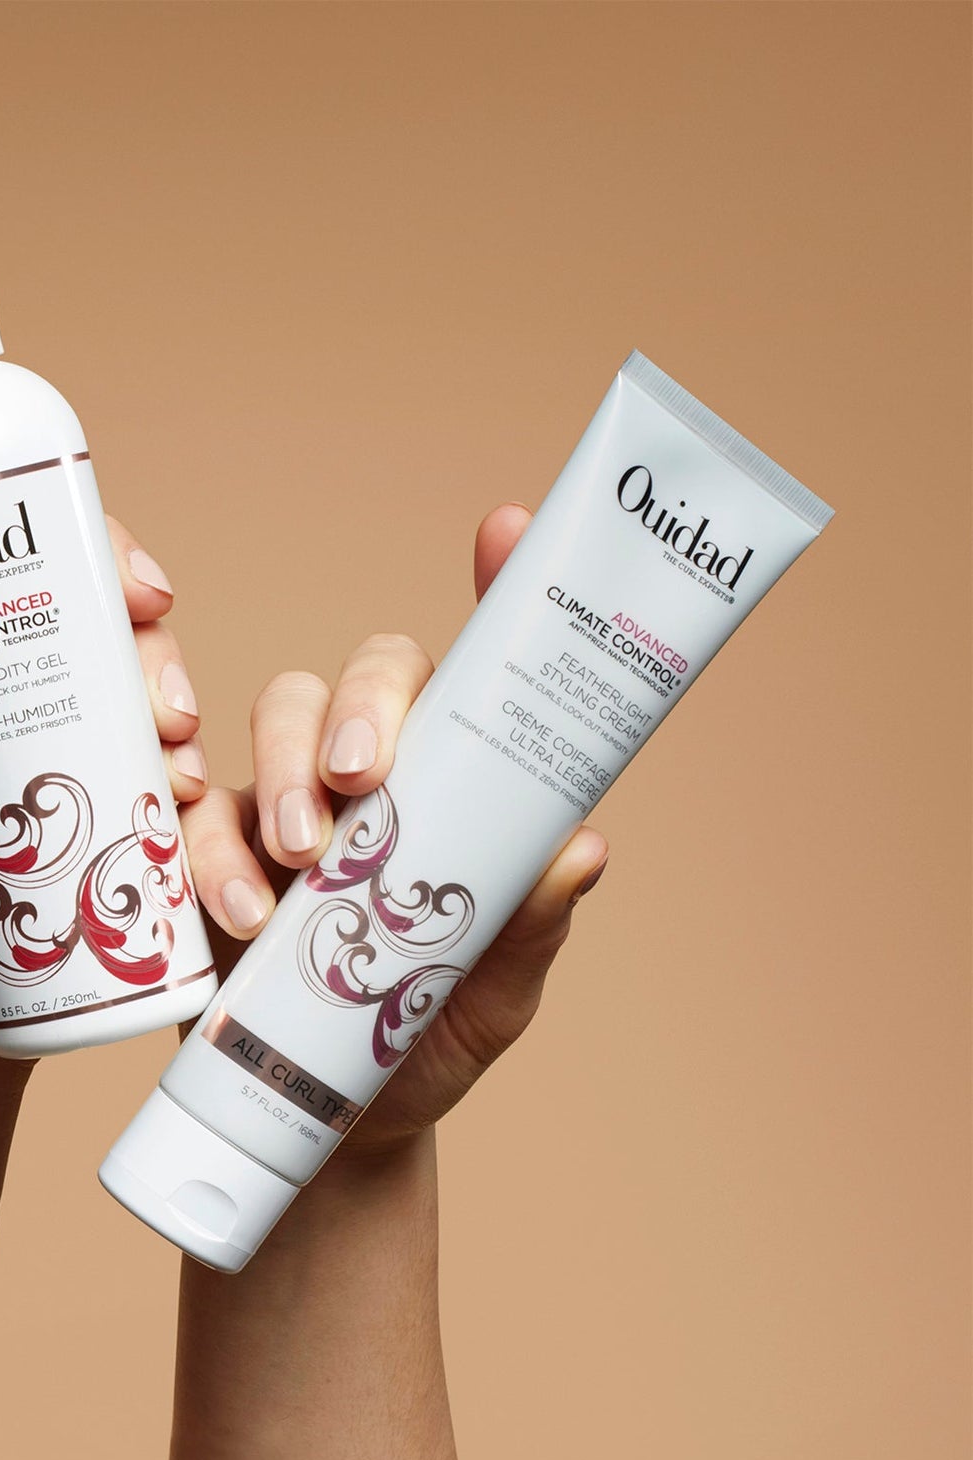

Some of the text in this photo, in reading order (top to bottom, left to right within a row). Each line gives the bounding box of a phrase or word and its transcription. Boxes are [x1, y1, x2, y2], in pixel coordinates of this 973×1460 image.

[617, 465, 754, 592] Ouidad
[662, 551, 677, 566] THE
[678, 561, 697, 579] CURL
[547, 586, 612, 639] CLIMATE
[2, 626, 60, 647] TECHNOLOGY
[611, 612, 688, 674] ADVANCED
[12, 682, 28, 693] OUT
[31, 672, 71, 688] HUMIDITY
[37, 653, 68, 671] GEL
[568, 621, 669, 699] ANTI-FRIZZ NANO TECHNOLOGY
[504, 661, 536, 687] DEFINE
[562, 702, 585, 721] LOCK
[584, 719, 601, 735] OUT
[539, 662, 641, 744] STYLING CREAM
[558, 652, 652, 727] FEATHERLIGHT
[41, 714, 82, 730] FRISOTTIS
[449, 710, 485, 738] DESSINE
[485, 734, 502, 750] LES
[509, 727, 554, 768] ULTRA
[553, 736, 611, 786] COIFFAGE
[53, 997, 58, 1010] /
[61, 990, 102, 1007] 250mL
[231, 1037, 264, 1069] ALL
[271, 1064, 316, 1104] CURL
[241, 1085, 258, 1098] 5.7
[289, 1120, 299, 1128] /
